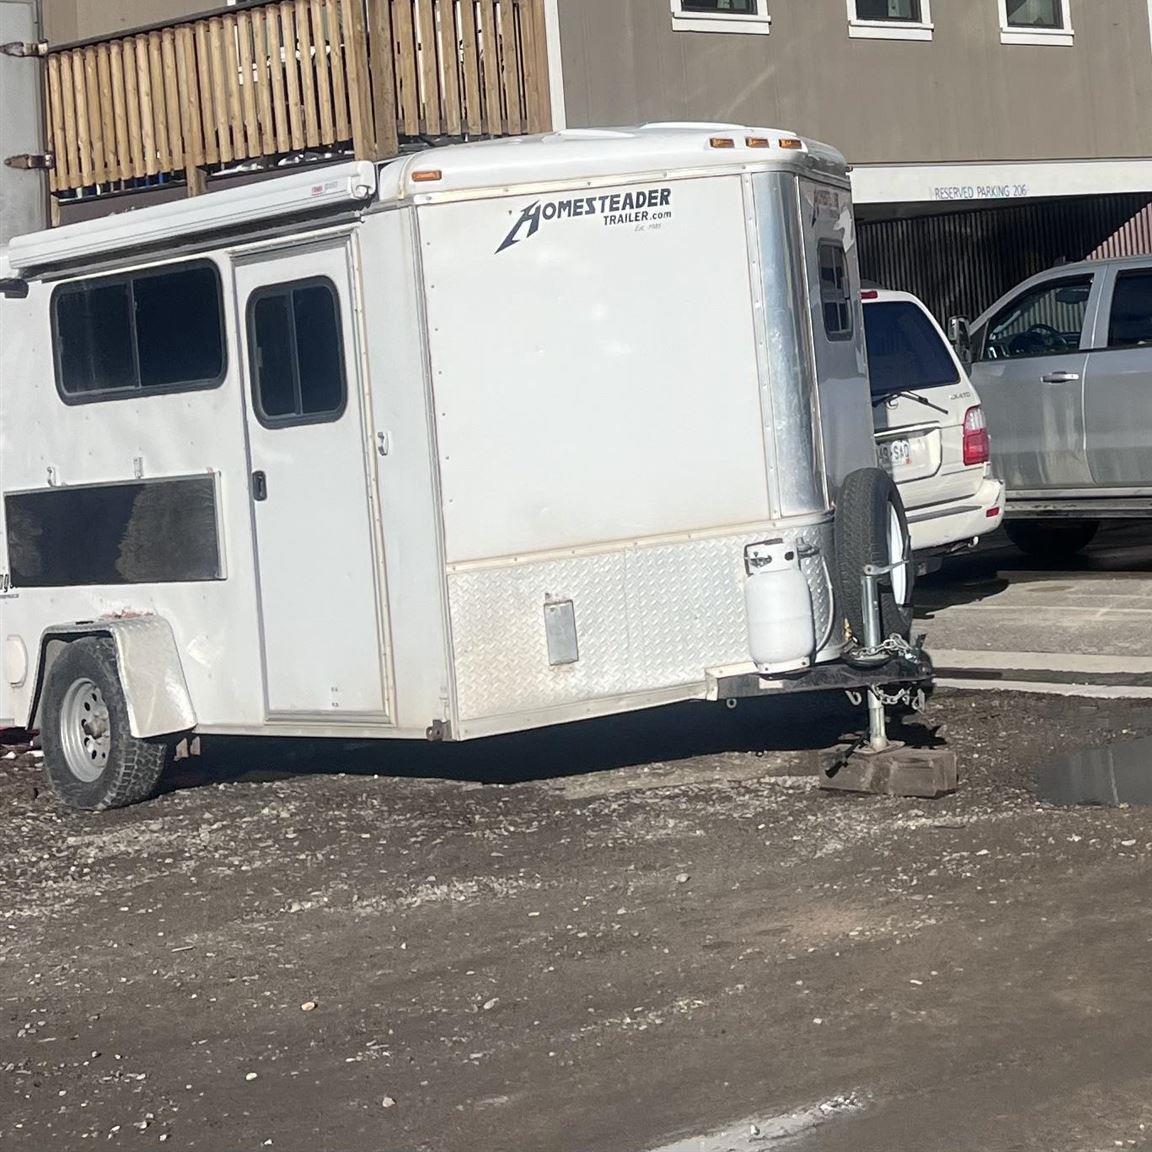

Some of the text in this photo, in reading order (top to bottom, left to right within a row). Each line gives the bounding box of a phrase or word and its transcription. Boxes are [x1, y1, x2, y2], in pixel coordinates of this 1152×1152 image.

[934, 186, 974, 200] RESERVED
[976, 185, 1010, 198] PARKING
[494, 188, 672, 254] HOMESTEADER
